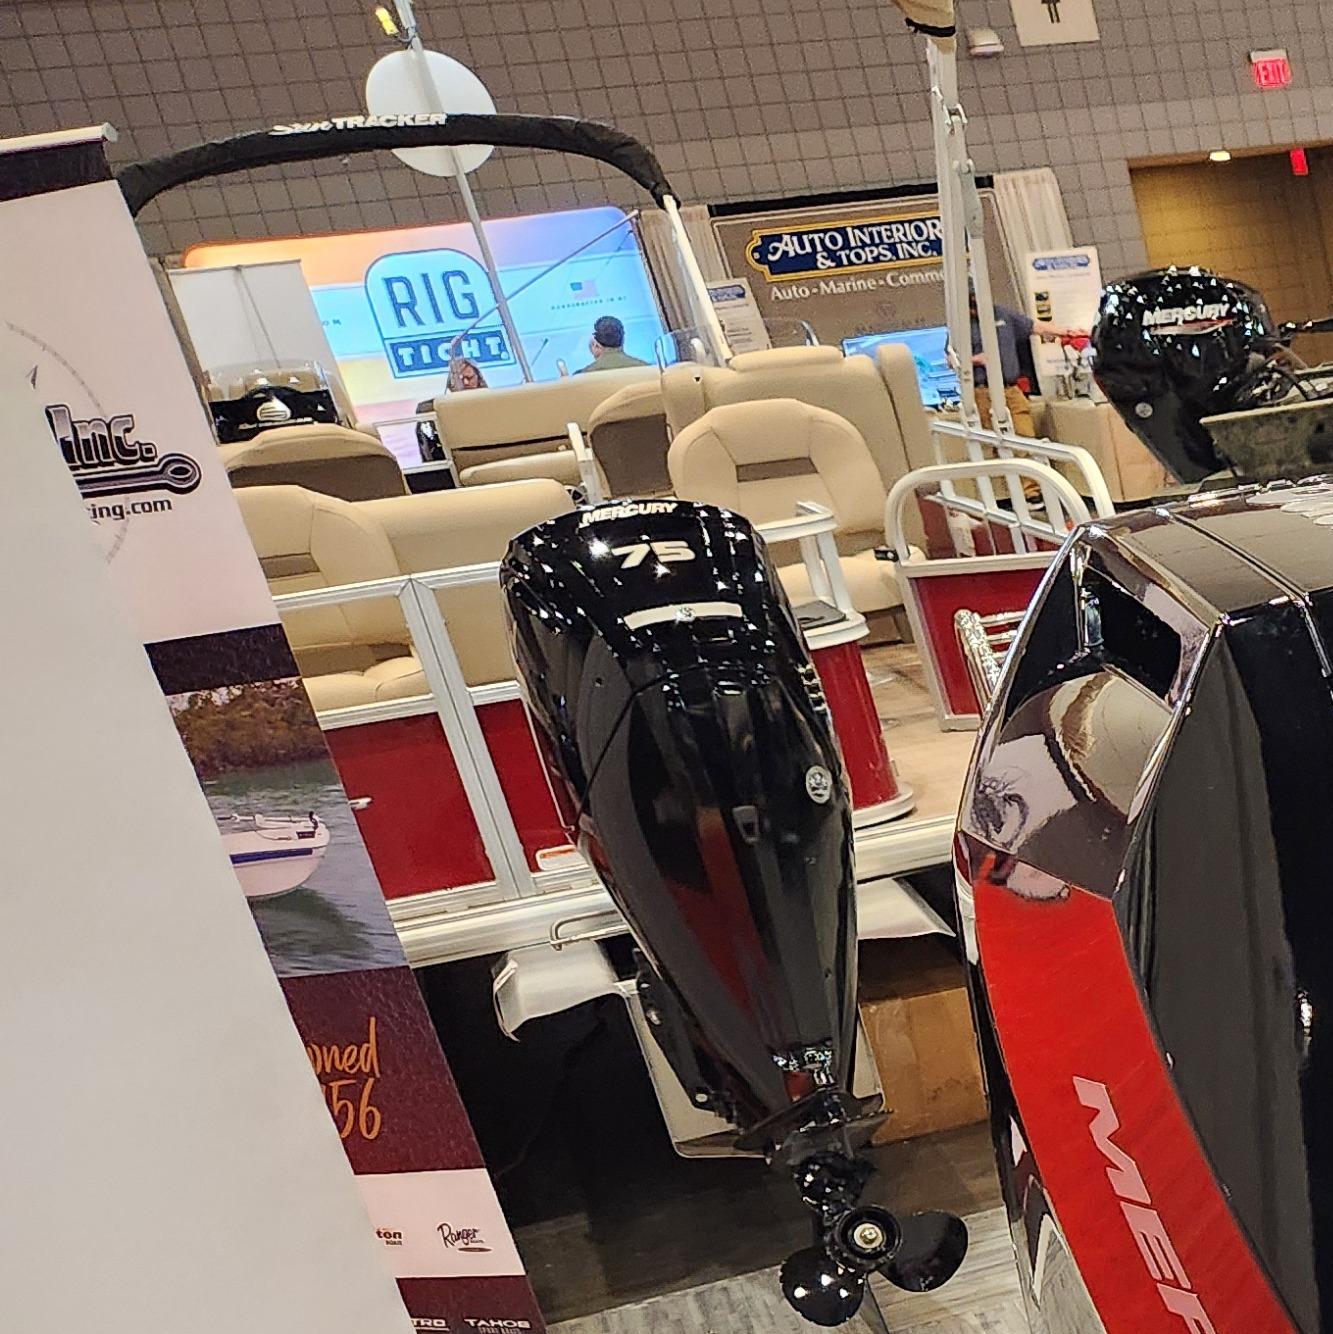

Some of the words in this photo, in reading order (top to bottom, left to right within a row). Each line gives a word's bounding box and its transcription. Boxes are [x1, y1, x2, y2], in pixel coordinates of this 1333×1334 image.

[766, 231, 843, 262] AUTO
[847, 218, 943, 244] INTERIOR
[815, 250, 836, 271] &
[898, 241, 938, 260] INC.
[381, 268, 480, 328] RIG
[1142, 302, 1232, 327] MERCURY
[87, 499, 172, 521] ing.com
[578, 501, 678, 529] MERCURY
[611, 540, 697, 570] 75
[322, 1077, 382, 1140] 56
[437, 1222, 481, 1248] Ranger
[463, 1317, 531, 1329] TAHOE
